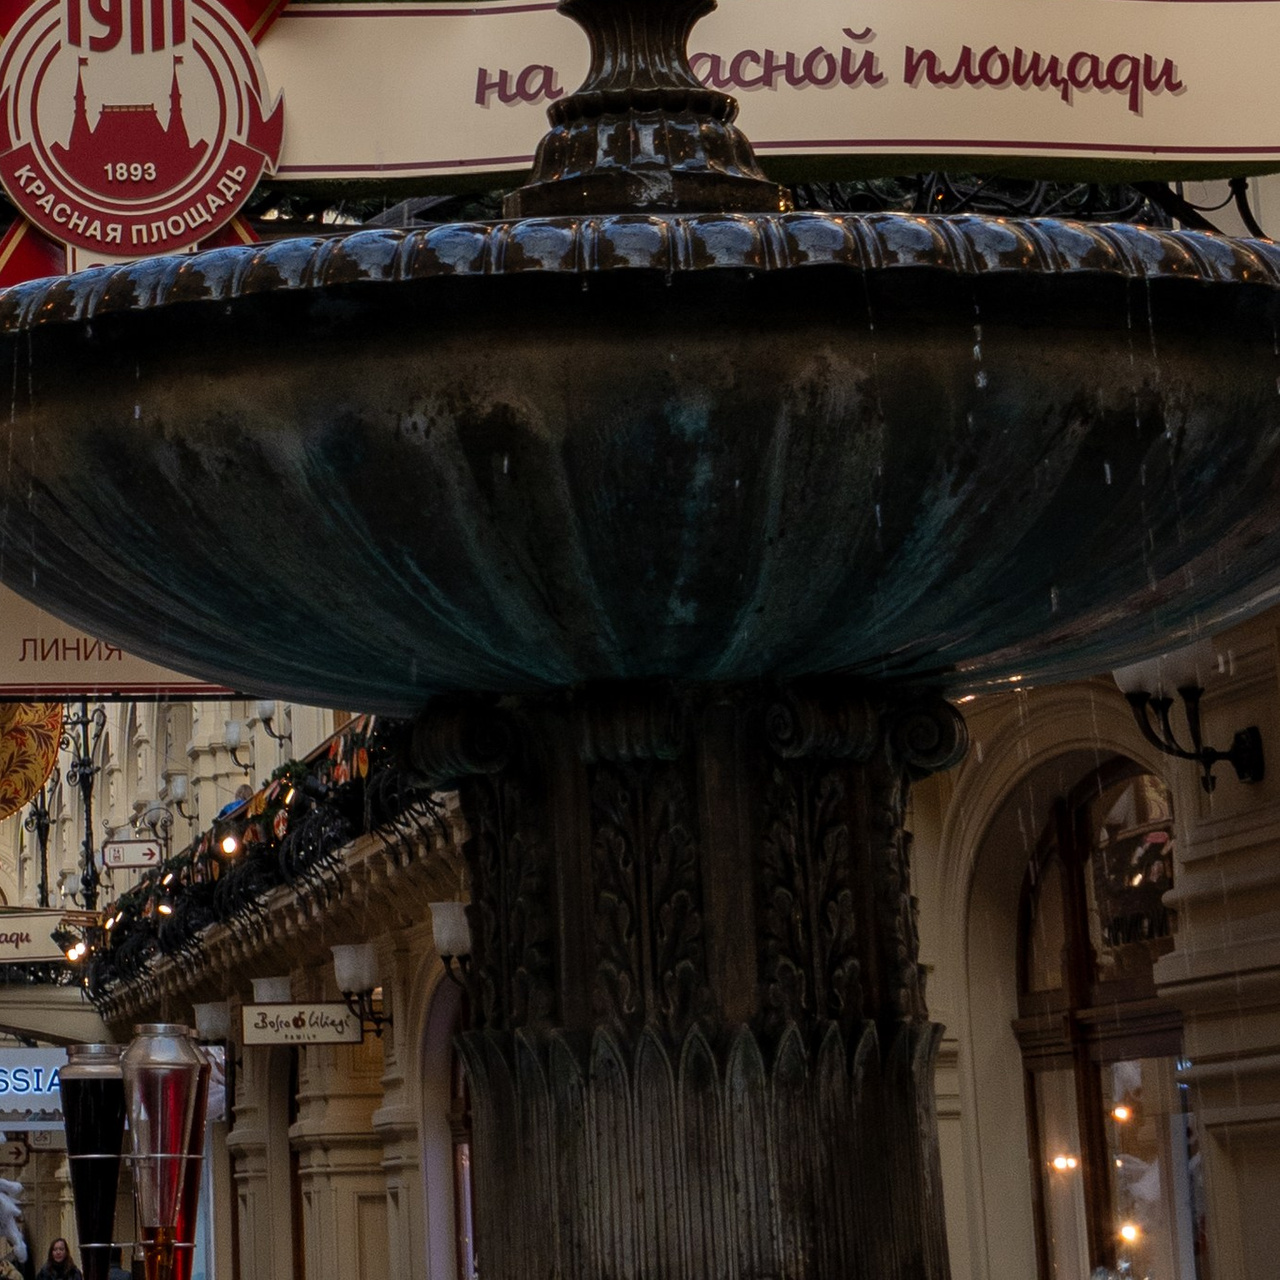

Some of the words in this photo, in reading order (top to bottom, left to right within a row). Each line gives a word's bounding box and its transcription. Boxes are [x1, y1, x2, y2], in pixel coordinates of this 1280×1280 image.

[474, 64, 564, 108] на
[687, 26, 885, 92] асной
[903, 45, 1186, 116] площади
[103, 162, 157, 182] 1893
[13, 163, 123, 244] КРАСНАЯ
[131, 163, 248, 245] ПЛОЩАДЬ
[18, 637, 123, 662] ЛИНИЯ
